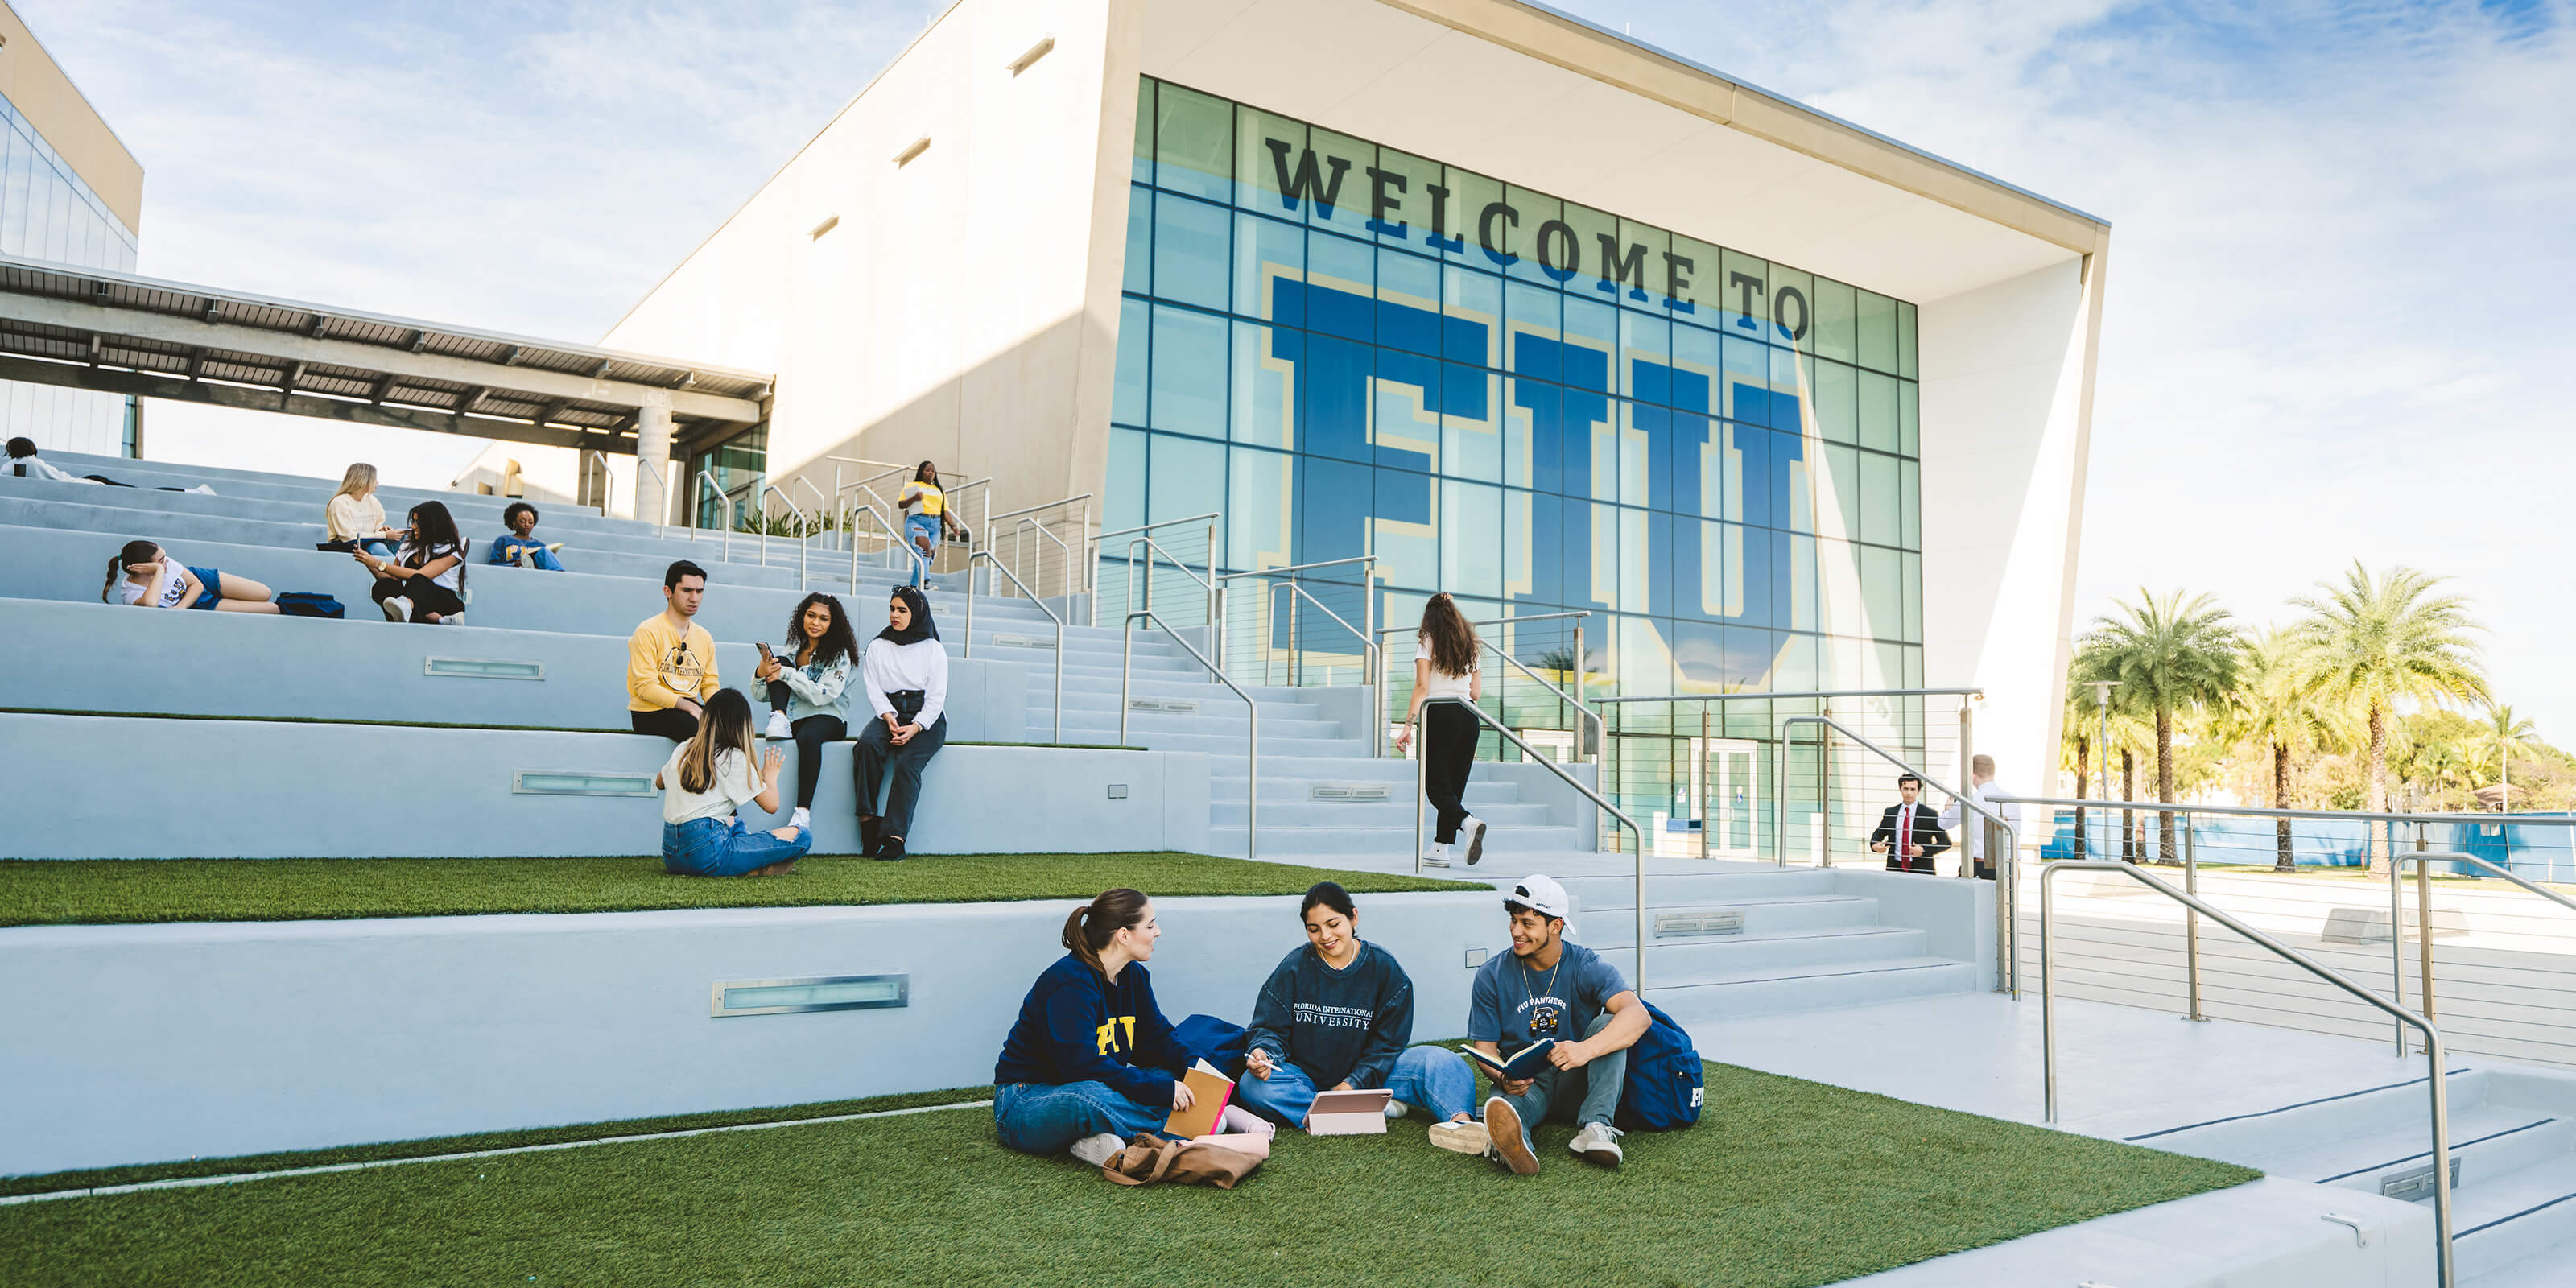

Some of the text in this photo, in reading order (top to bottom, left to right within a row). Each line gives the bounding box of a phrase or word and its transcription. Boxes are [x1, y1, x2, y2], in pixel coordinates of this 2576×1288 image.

[1265, 137, 1809, 341] WELCOME TO
[1257, 261, 1810, 692] FIU
[506, 545, 527, 561] FI
[1294, 1003, 1321, 1012] FLORIDA
[1517, 997, 1567, 1014] FIU PANTHERS
[1295, 1013, 1369, 1030] UNIVERSITY
